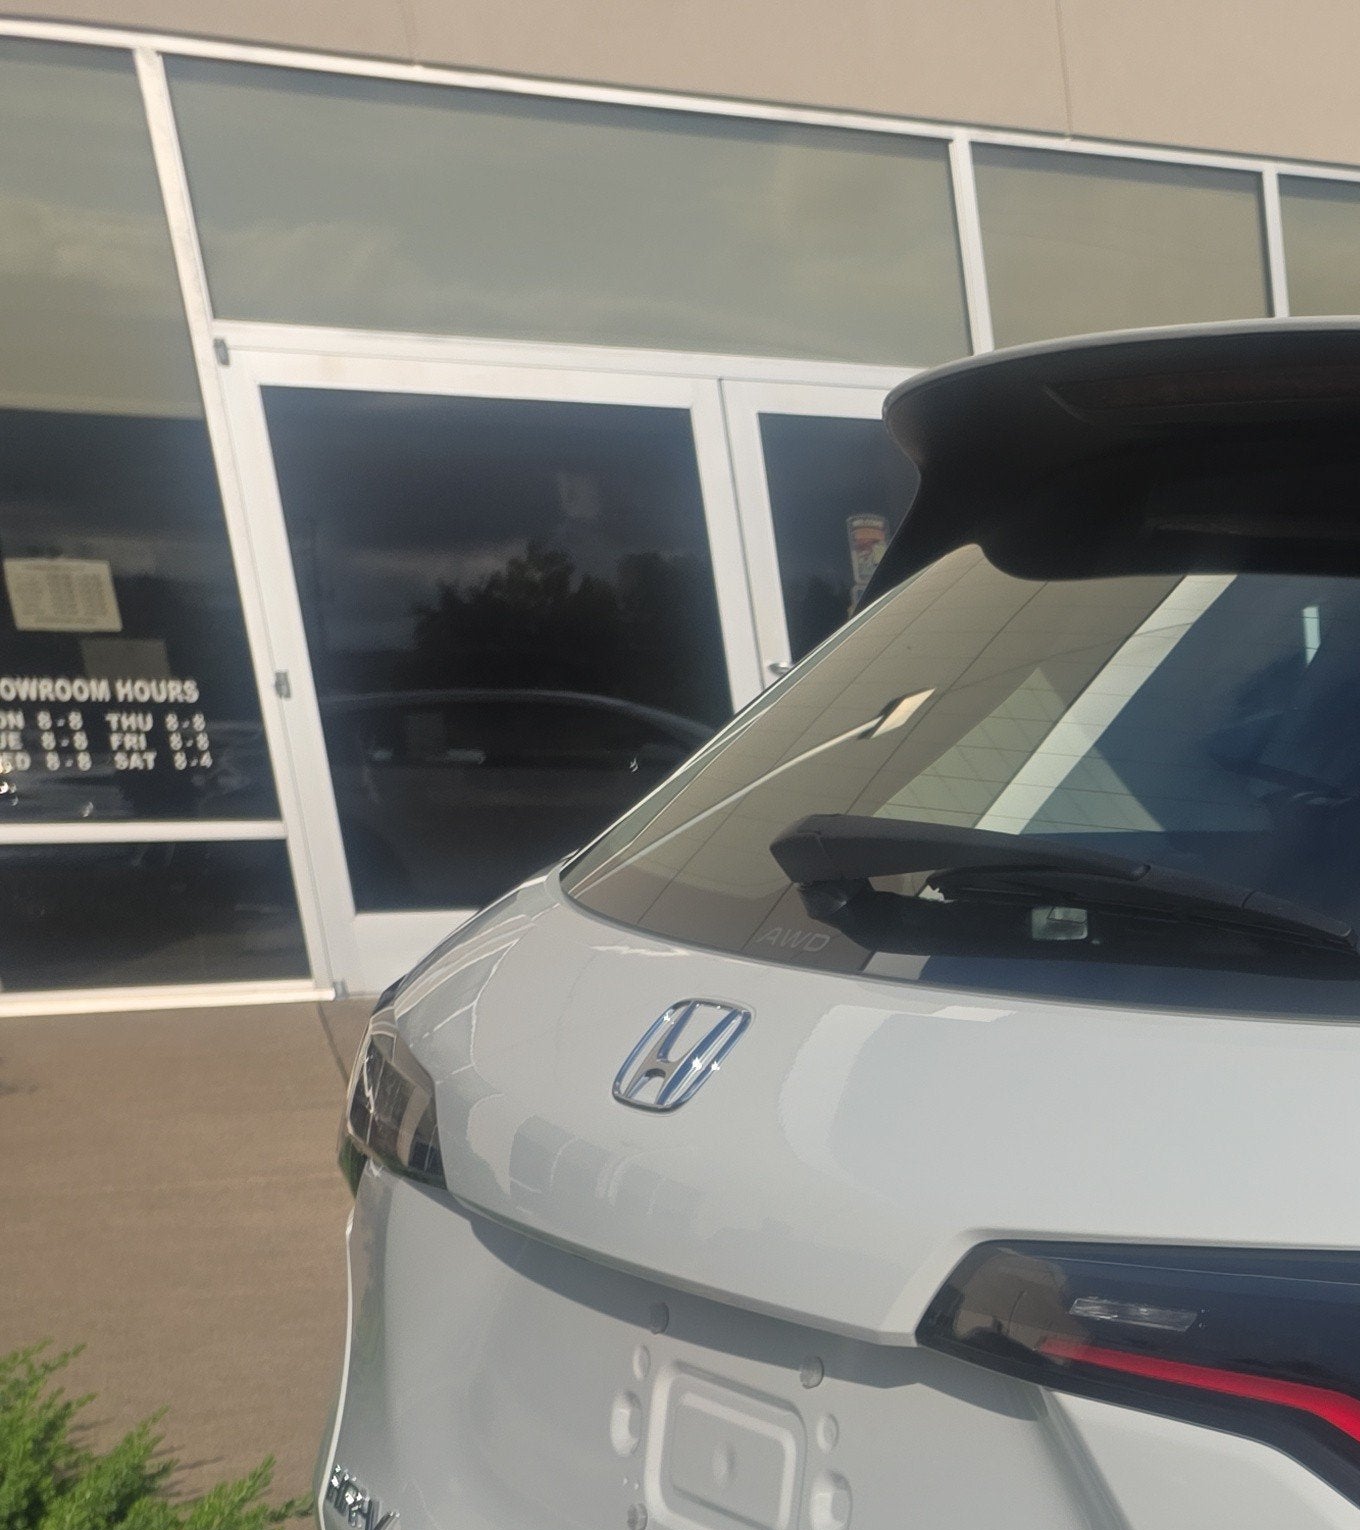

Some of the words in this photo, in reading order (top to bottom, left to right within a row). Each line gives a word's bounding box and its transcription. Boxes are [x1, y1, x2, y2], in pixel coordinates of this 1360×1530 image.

[115, 678, 199, 703] HOURS
[105, 712, 153, 732] THU
[110, 733, 148, 750] FRI
[114, 751, 157, 770] SAT
[757, 927, 831, 952] AWD
